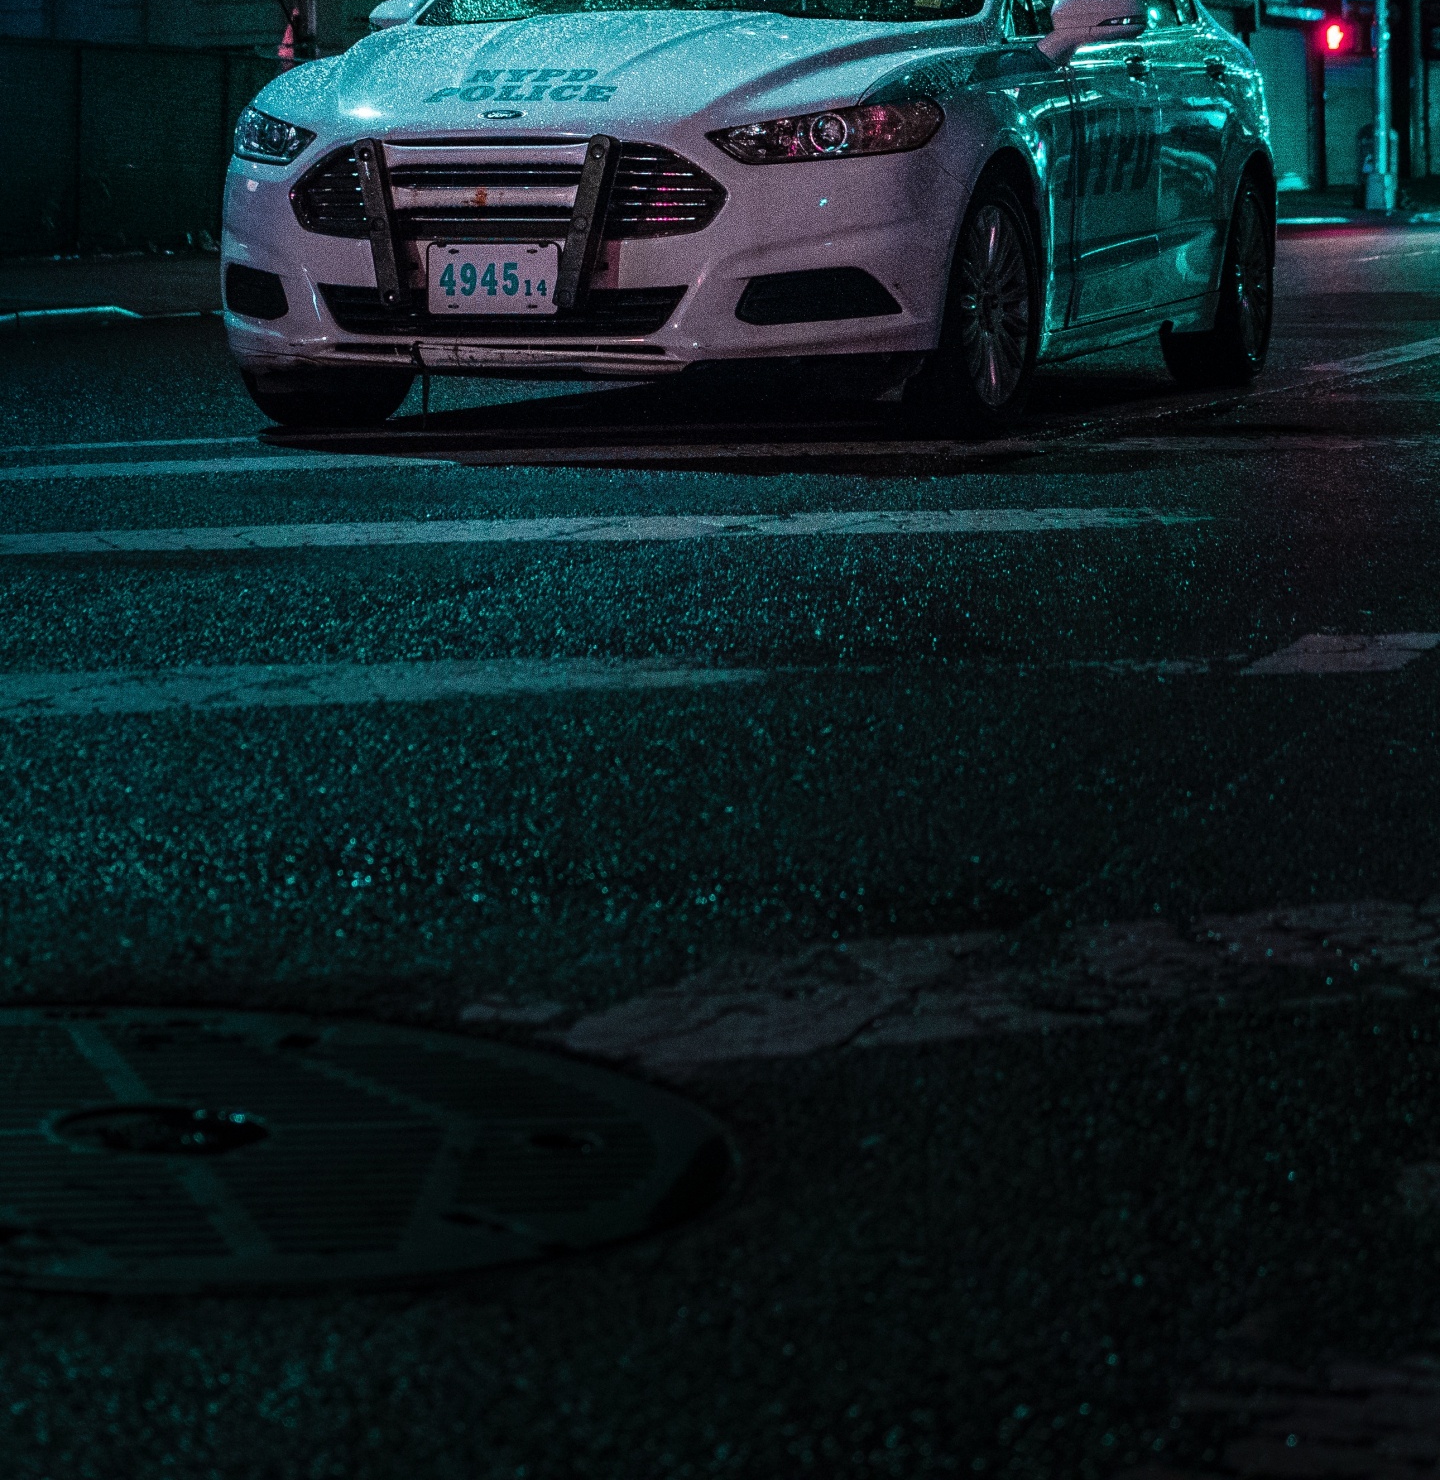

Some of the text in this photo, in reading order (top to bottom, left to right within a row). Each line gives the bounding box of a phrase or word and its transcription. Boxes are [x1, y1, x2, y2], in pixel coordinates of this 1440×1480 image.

[465, 68, 599, 83] NYPD
[422, 85, 618, 103] POLICE
[439, 262, 548, 297] 4945 14
